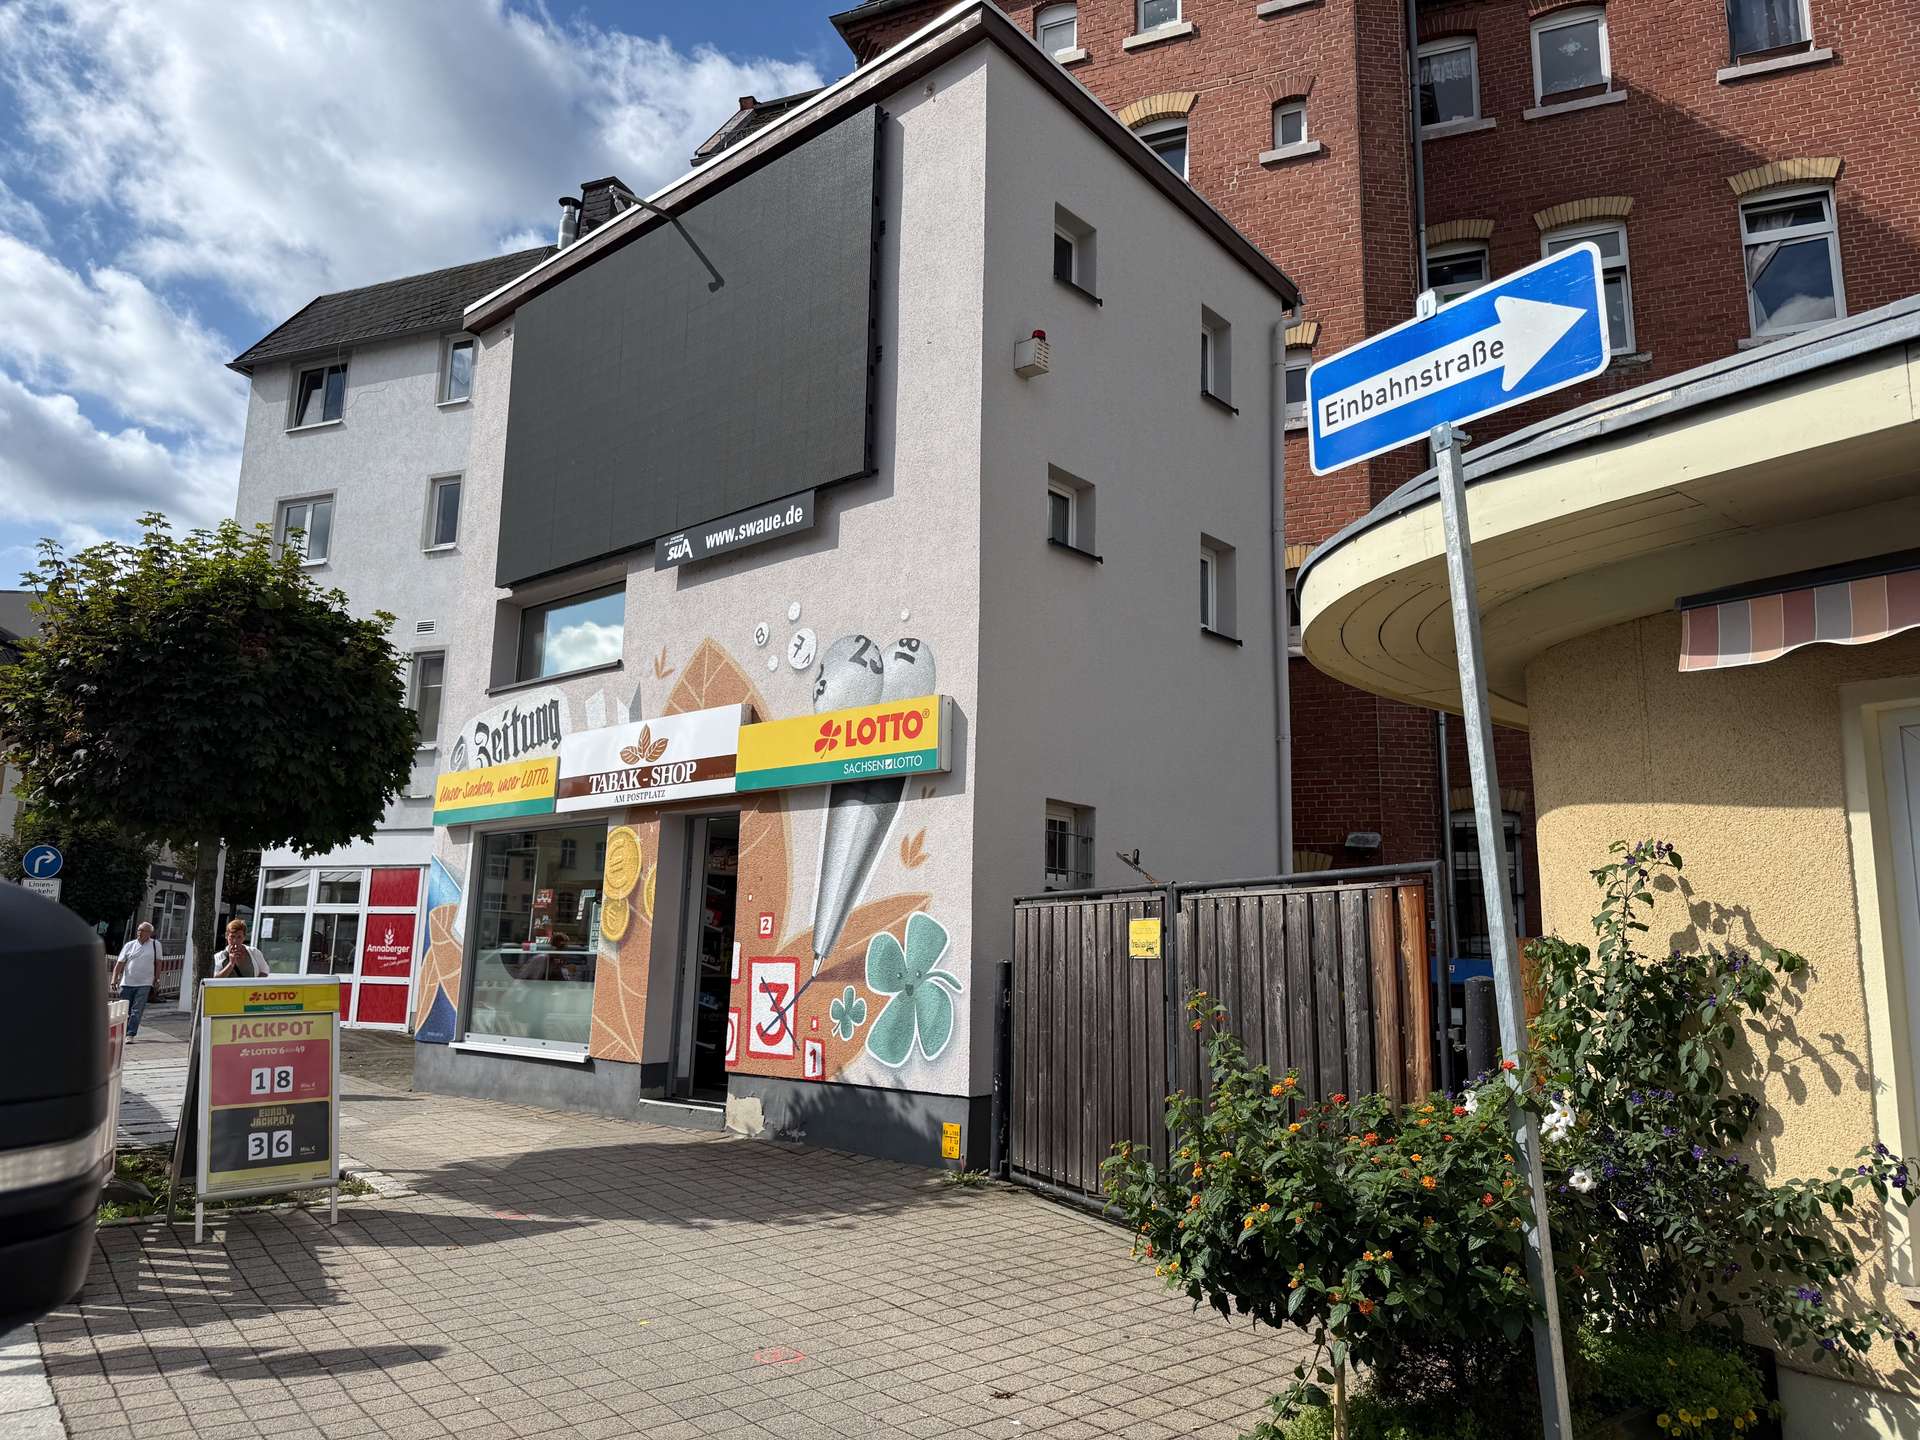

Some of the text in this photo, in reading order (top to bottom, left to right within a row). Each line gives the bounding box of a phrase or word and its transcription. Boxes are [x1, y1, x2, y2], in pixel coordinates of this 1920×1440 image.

[1325, 340, 1504, 427] Einbahnstraße
[705, 505, 803, 549] www.swaue.de
[755, 627, 765, 645] 8
[793, 634, 805, 658] 7
[474, 699, 561, 768] Zeitung
[440, 767, 549, 803] Unser Sachsen, unser LOTTO.
[589, 768, 642, 794] TABAK
[650, 761, 697, 787] SHOP
[614, 789, 666, 803] AM POSTPLATZ
[762, 918, 769, 931] 2
[367, 944, 410, 955] Annaberger
[263, 992, 296, 1001] LOTTO
[756, 983, 790, 1046] 3
[231, 1021, 314, 1042] JACKPOT
[809, 1049, 817, 1073] 1
